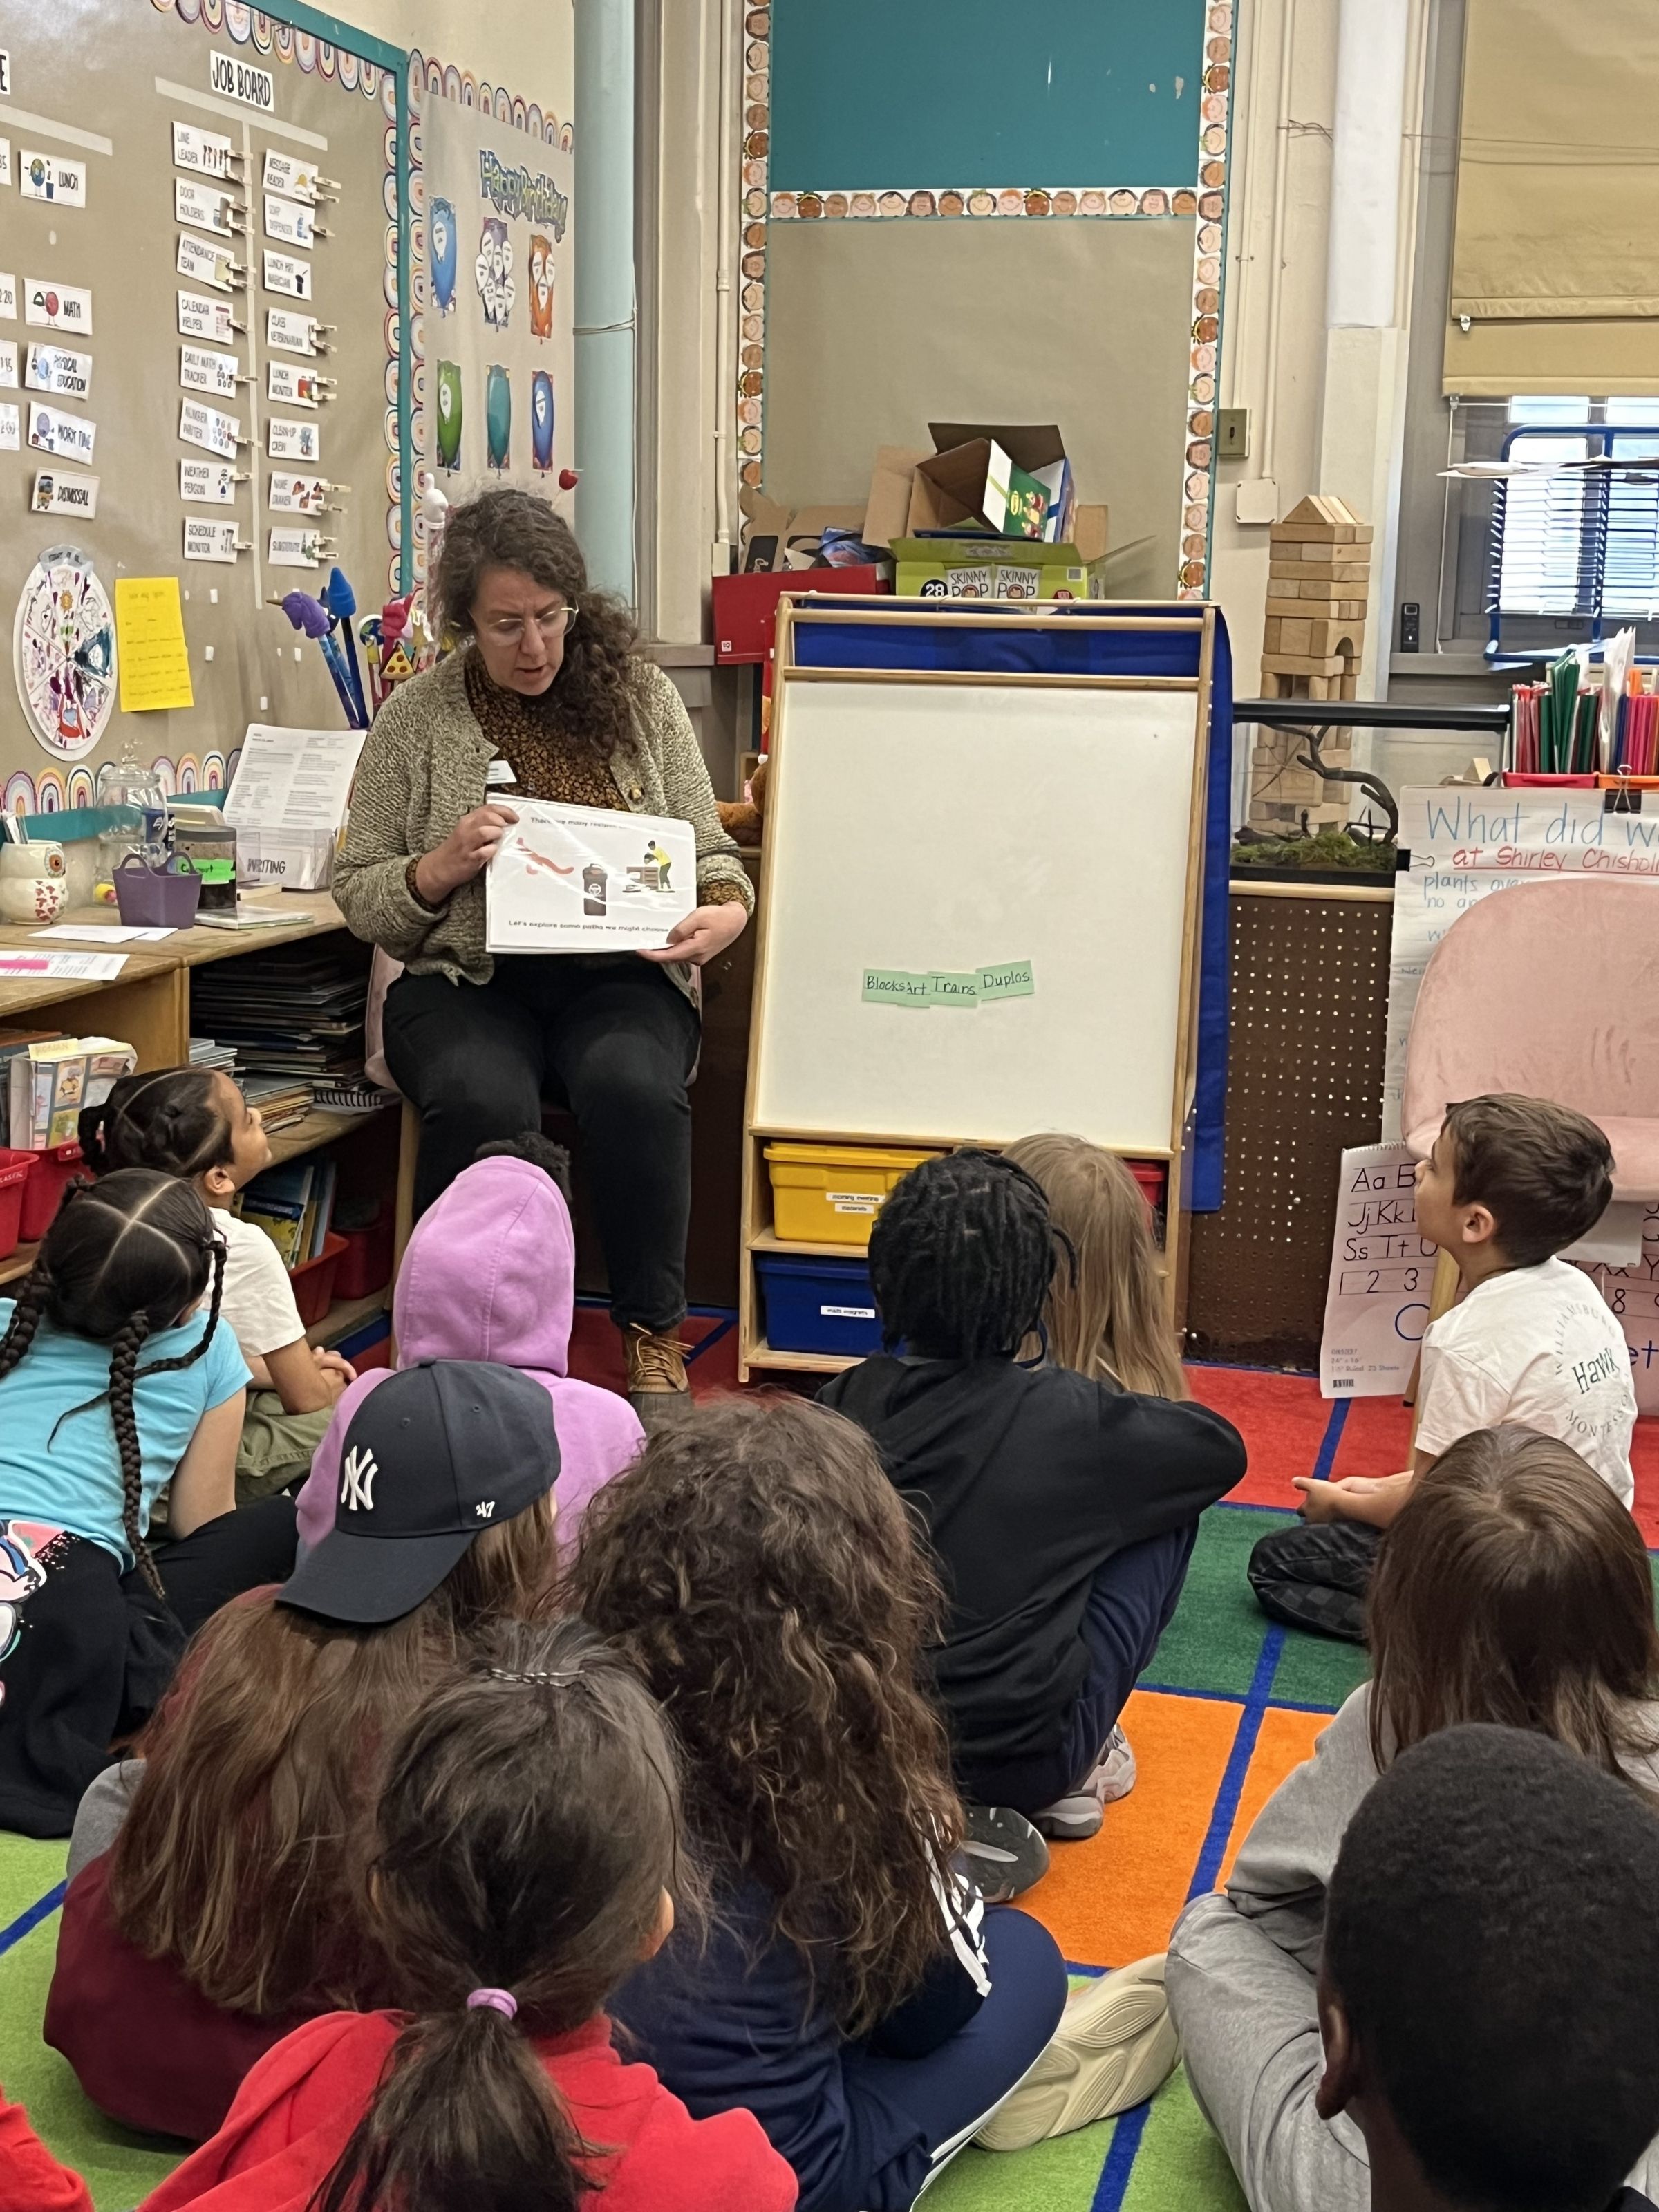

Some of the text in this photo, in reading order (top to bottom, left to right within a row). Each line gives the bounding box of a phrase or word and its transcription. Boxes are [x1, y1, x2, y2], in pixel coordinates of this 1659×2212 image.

[212, 57, 270, 106] JOB BOARD
[178, 149, 198, 164] LEADER
[59, 171, 78, 191] LUNCH
[182, 239, 215, 262] ATTENDANCE
[181, 256, 194, 272] TEAM
[64, 300, 81, 318] MATH
[182, 299, 209, 315] CALENDAR
[182, 316, 202, 330] HELPER
[185, 351, 200, 366] DAILY
[184, 368, 207, 384] TRACKER
[272, 424, 297, 438] CLEAN-UP
[184, 465, 209, 478] WEATHER
[57, 486, 89, 505] DISMISSAL
[184, 482, 205, 495] PERSON
[188, 524, 216, 538] SCHEDULE
[187, 541, 210, 553] MONITOR
[950, 569, 988, 585] SKINNY
[1000, 570, 1037, 585] SKINNY
[926, 583, 945, 597] 28
[1427, 796, 1530, 843] What
[1546, 800, 1606, 847] did
[247, 858, 285, 874] WRITING
[1452, 846, 1659, 874] at Shirley Chishol
[1424, 872, 1478, 900] plants
[1427, 897, 1444, 908] no
[867, 971, 1030, 995] Blocks Art Trains Duplos
[1367, 1270, 1380, 1293] 2
[1403, 1268, 1418, 1291] 3
[1612, 1289, 1626, 1313] 8
[341, 1445, 378, 1511] NY
